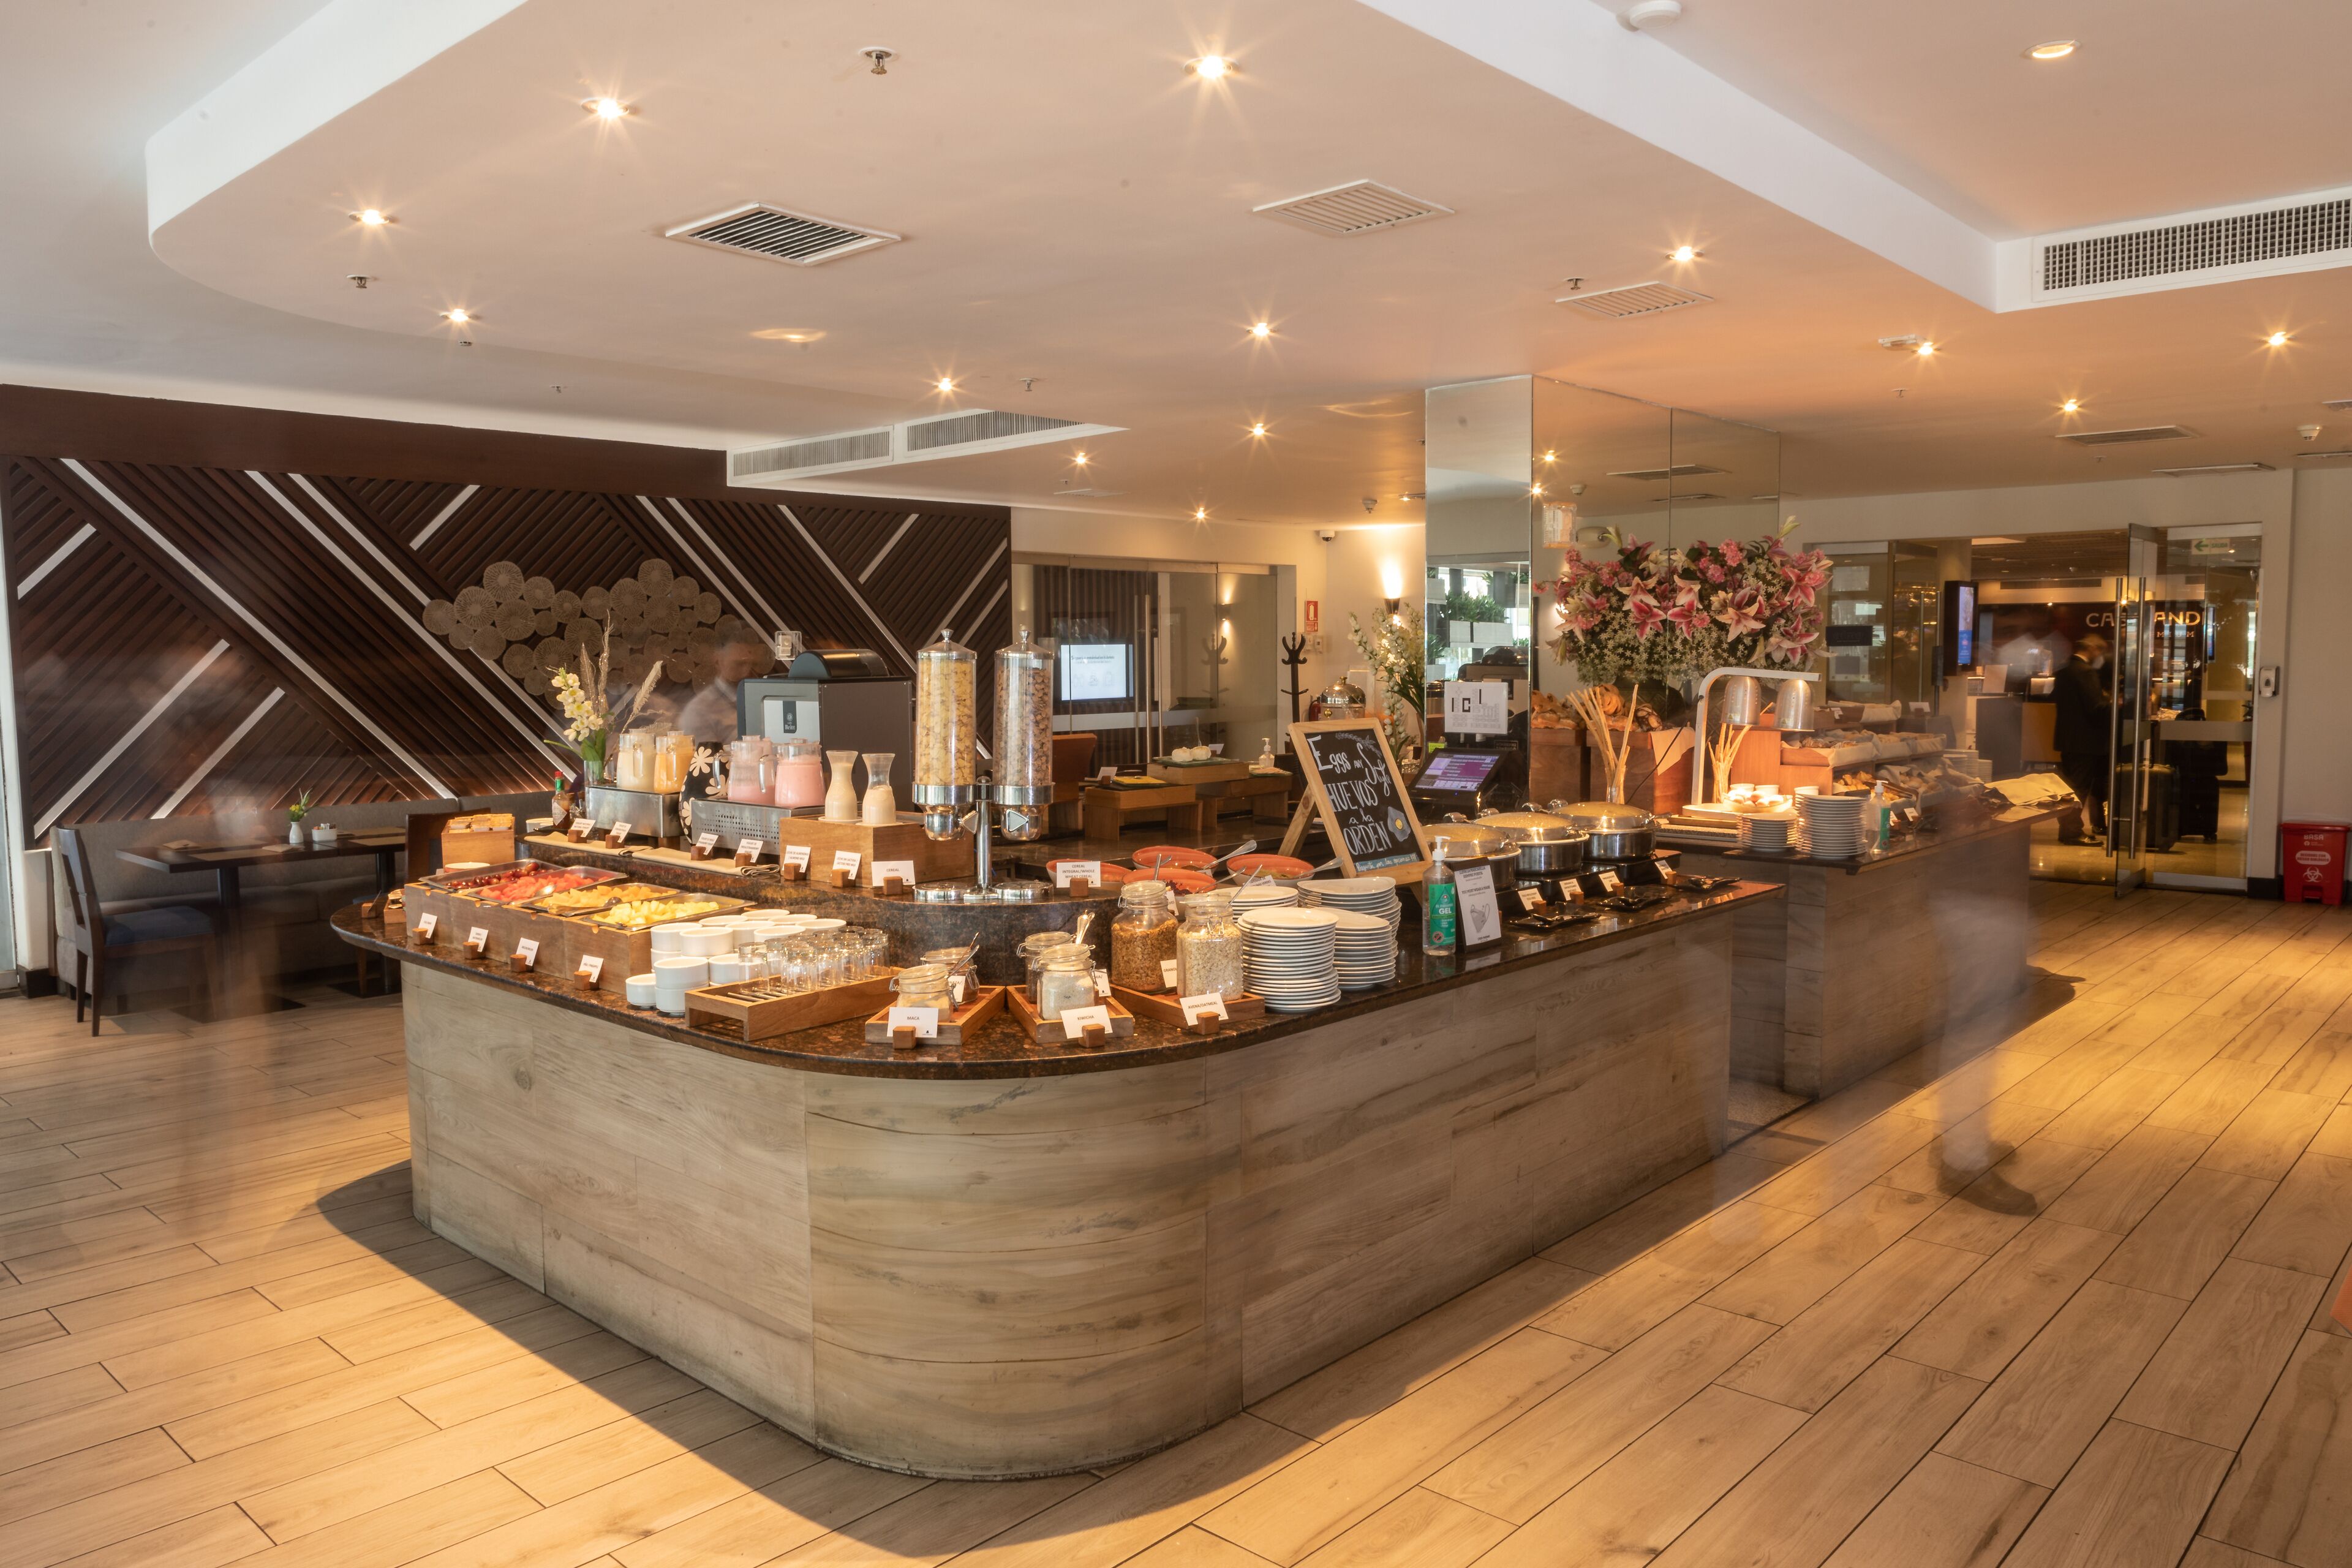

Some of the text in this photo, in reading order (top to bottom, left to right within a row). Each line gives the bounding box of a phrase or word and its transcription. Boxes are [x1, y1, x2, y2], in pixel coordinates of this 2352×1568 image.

[1307, 735, 1351, 774] Eggs
[1356, 742, 1392, 796] Style
[1324, 780, 1378, 812] HUEVOS
[1360, 808, 1374, 823] la
[1343, 821, 1392, 855] ORDEN
